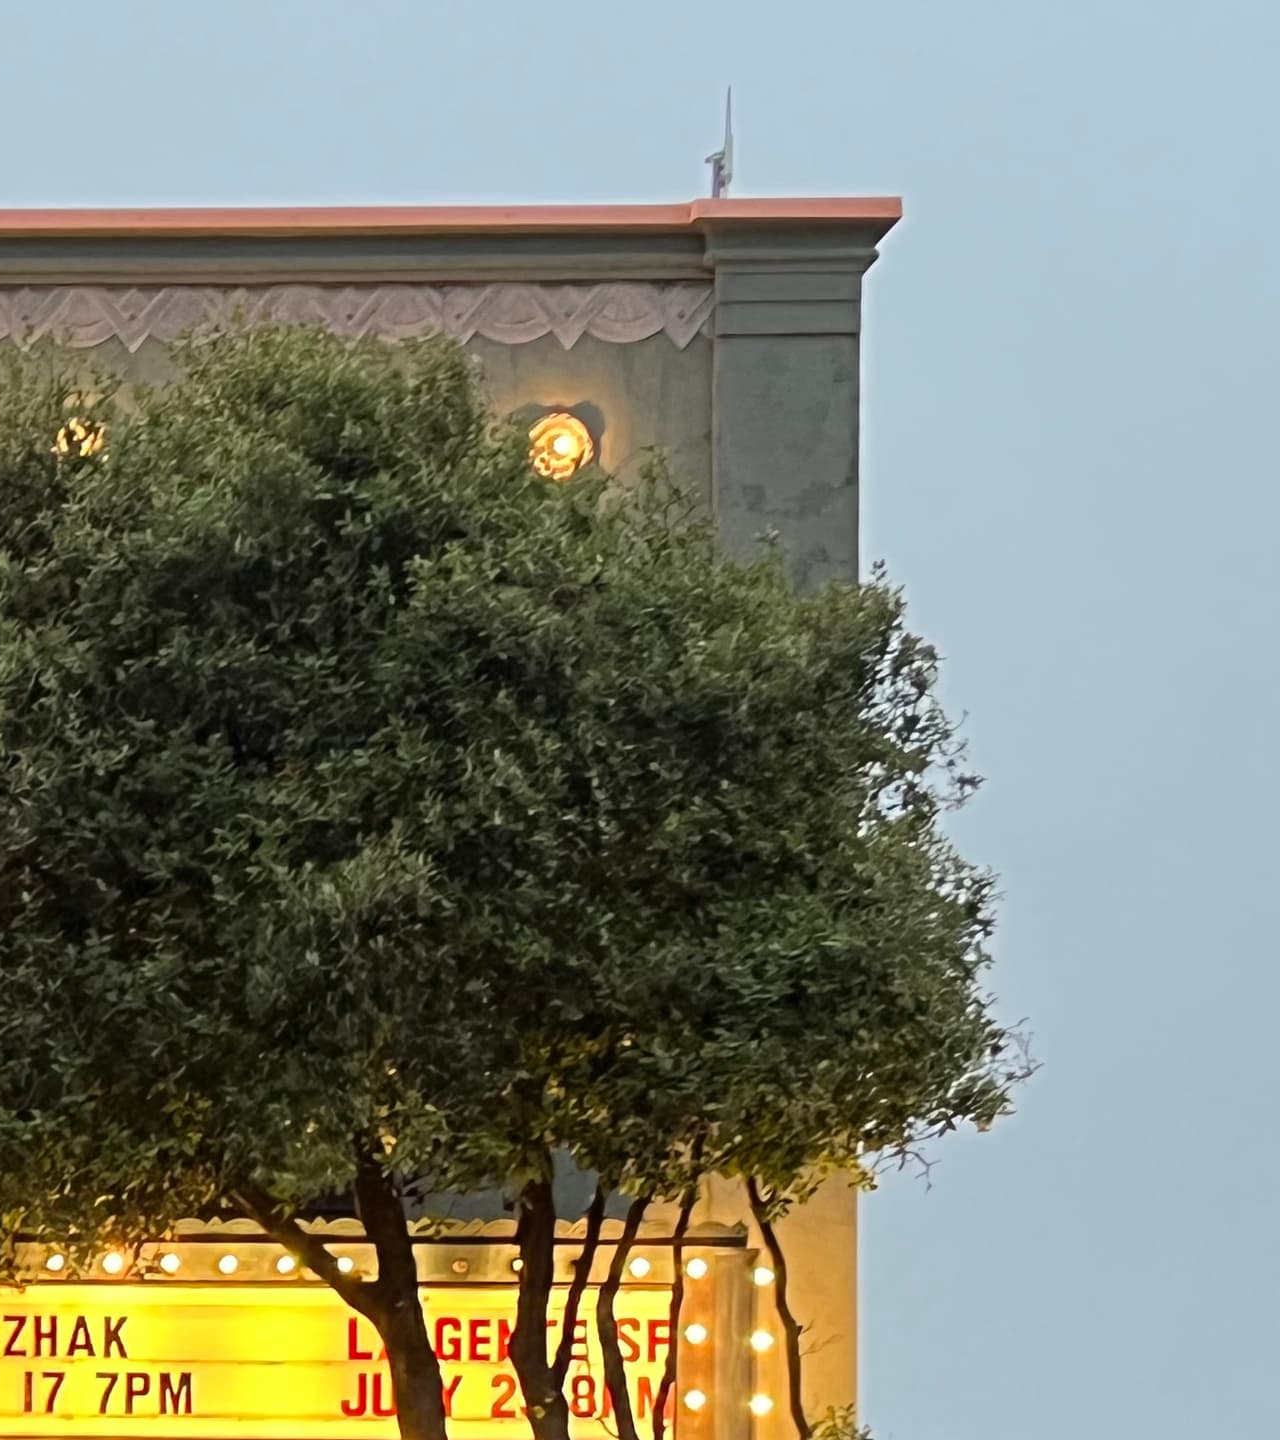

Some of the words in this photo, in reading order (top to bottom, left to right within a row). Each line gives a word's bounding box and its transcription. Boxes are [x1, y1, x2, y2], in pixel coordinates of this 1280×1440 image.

[434, 1317, 588, 1362] GEE
[22, 1371, 62, 1414] 17
[95, 1372, 194, 1416] 7PM
[340, 1372, 463, 1418] JUY
